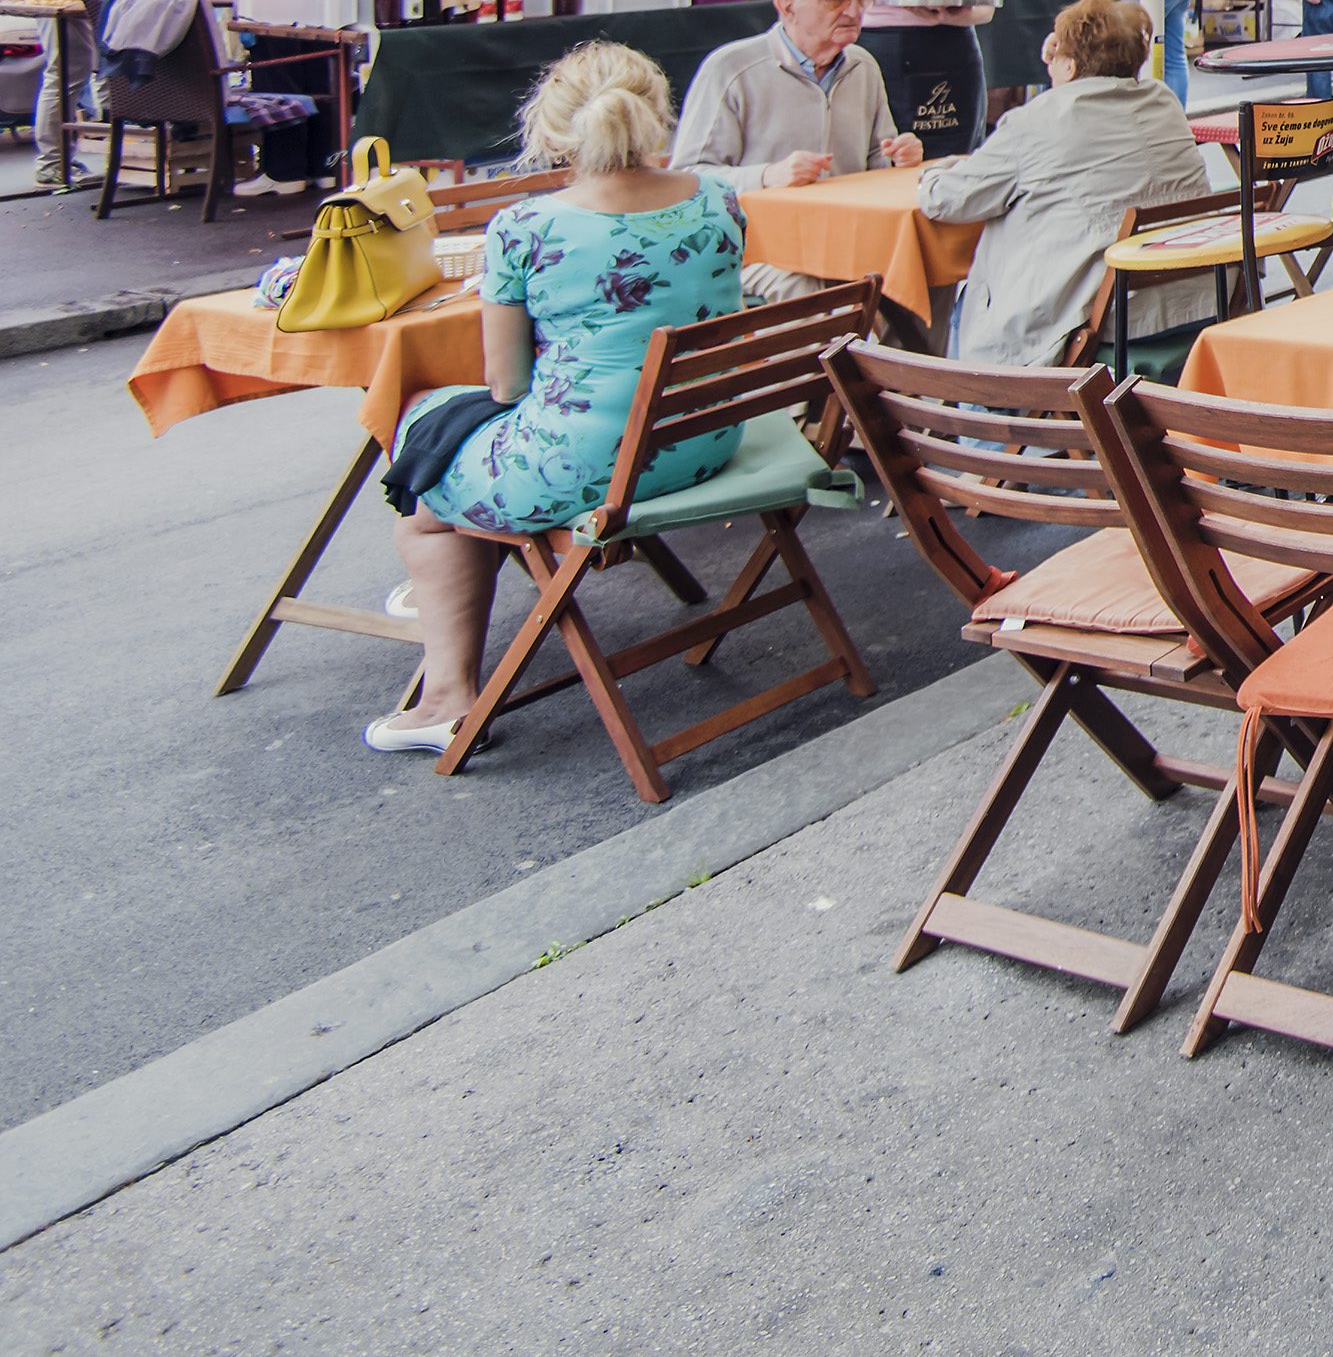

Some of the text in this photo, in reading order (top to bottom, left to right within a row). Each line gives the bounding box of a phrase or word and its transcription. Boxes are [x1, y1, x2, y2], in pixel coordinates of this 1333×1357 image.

[913, 117, 959, 130] FESTIGIA
[1261, 122, 1278, 132] Sve
[1280, 120, 1301, 131] ćemo
[1263, 132, 1294, 146] uz Žuju
